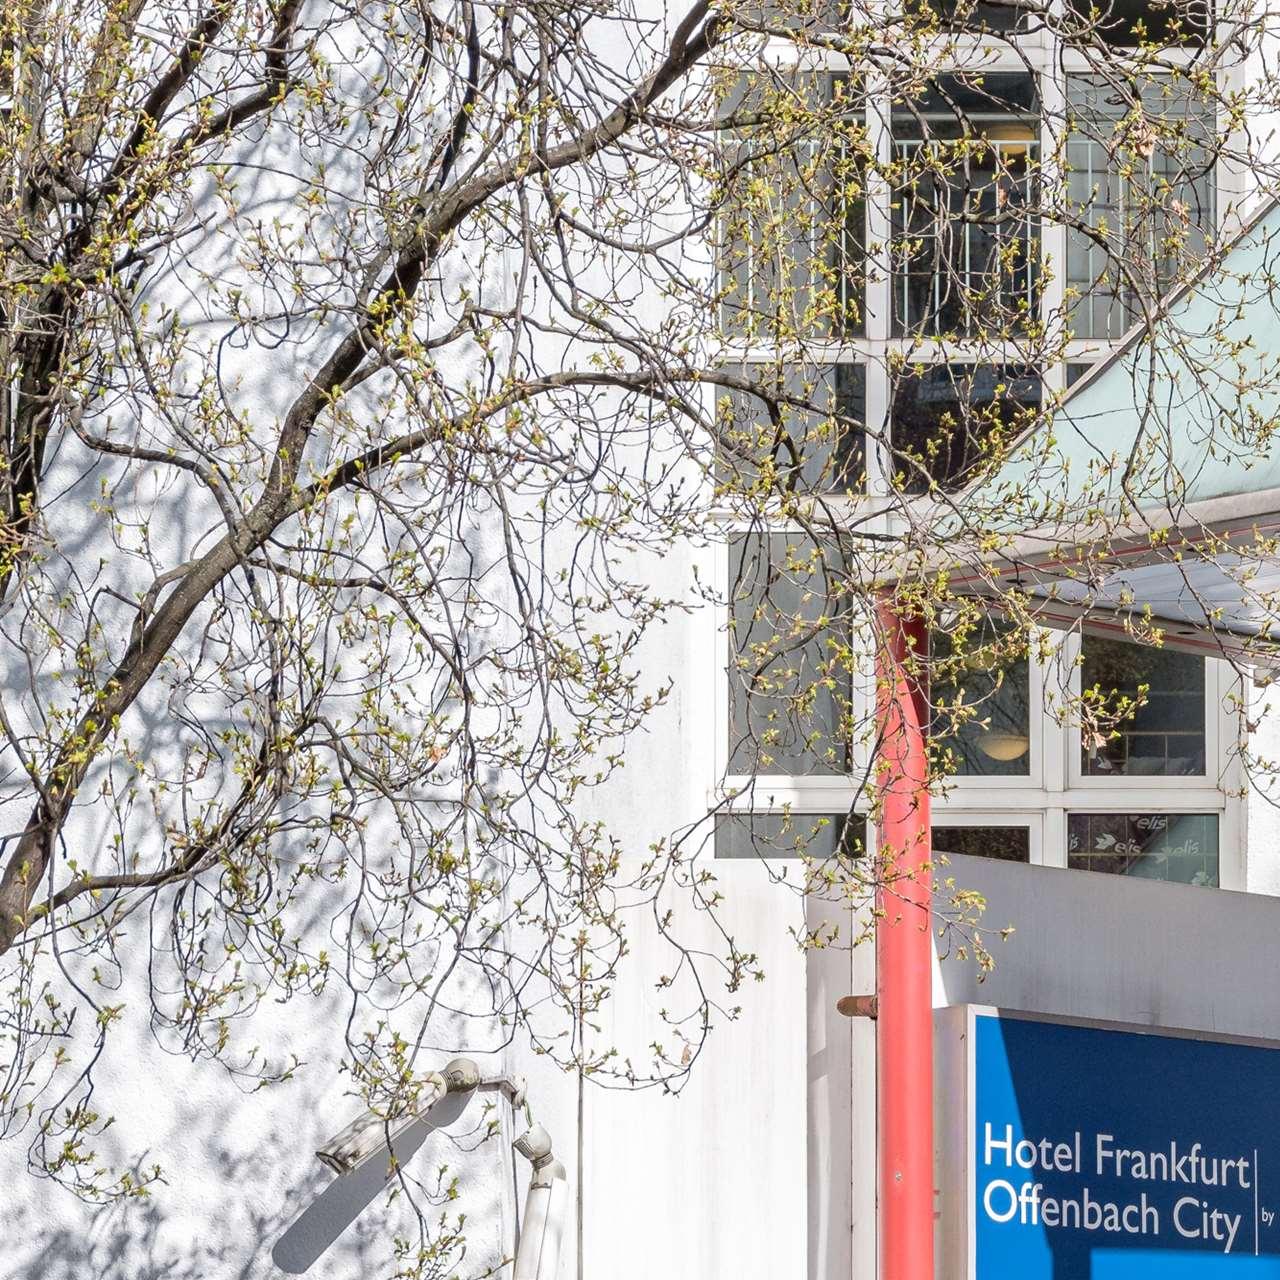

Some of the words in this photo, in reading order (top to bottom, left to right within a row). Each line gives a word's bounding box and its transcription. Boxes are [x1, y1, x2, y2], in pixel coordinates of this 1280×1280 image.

[1136, 815, 1167, 830] elis
[1114, 838, 1143, 855] elis
[984, 1121, 1081, 1173] Hotel
[1096, 1133, 1251, 1189] Frankfurt
[983, 1179, 1160, 1235] Offenbach
[1173, 1196, 1242, 1254] City
[1261, 1207, 1275, 1227] by
